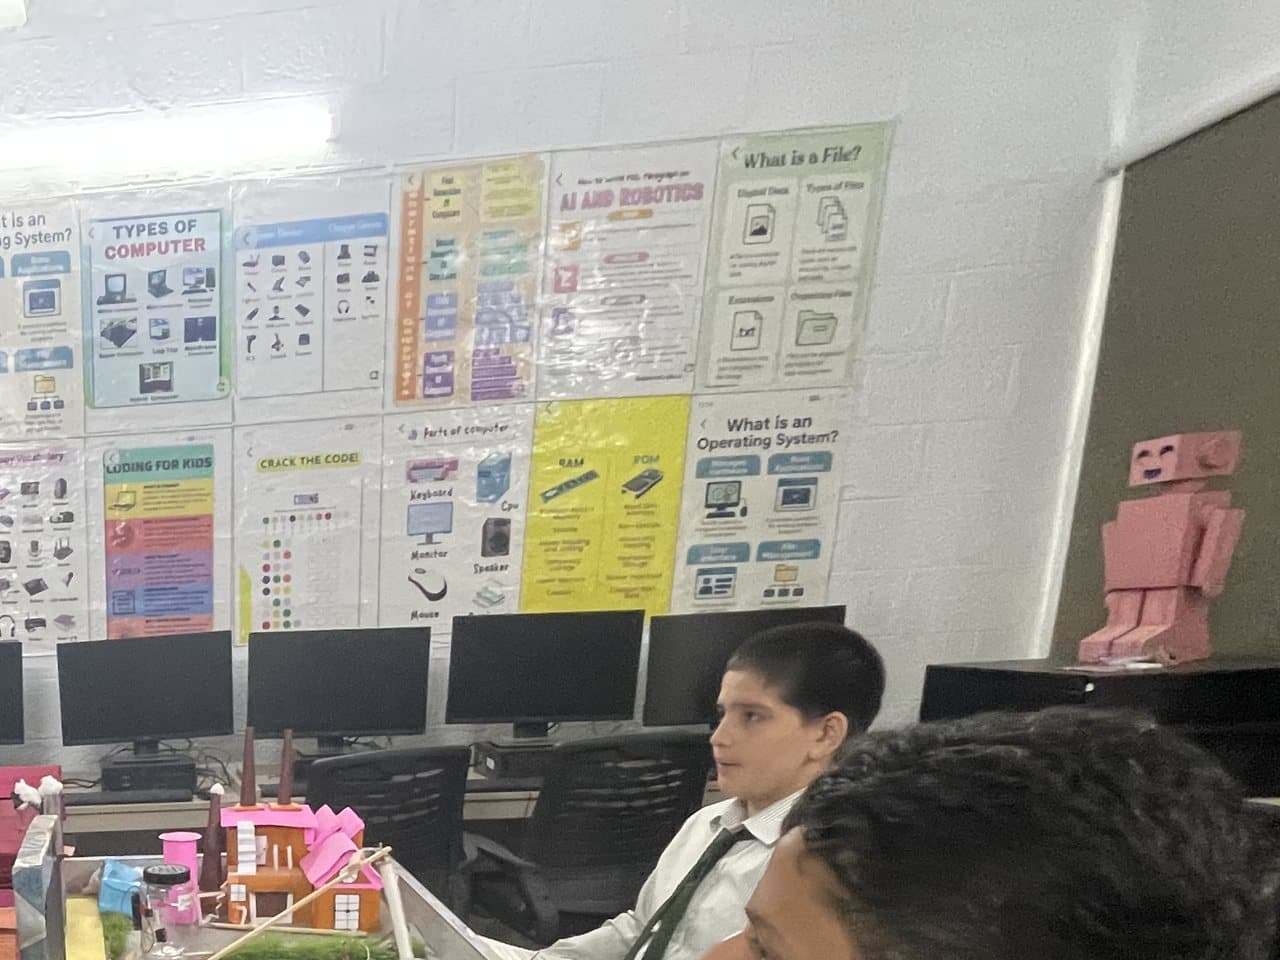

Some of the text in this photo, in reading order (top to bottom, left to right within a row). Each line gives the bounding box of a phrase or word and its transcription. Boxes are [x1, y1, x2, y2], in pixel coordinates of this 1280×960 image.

[744, 145, 862, 168] What is a File?
[560, 183, 704, 212] AI AND ROBOTICS
[28, 214, 46, 227] an
[112, 220, 197, 240] TYPES OF
[15, 228, 72, 248] System?
[105, 238, 206, 260] COMPUTER
[728, 414, 812, 432] What is an
[451, 426, 461, 436] of
[697, 430, 839, 452] Operating System?
[156, 460, 179, 471] FOR
[182, 457, 212, 469] KIDS
[260, 453, 358, 468] CRACK THE CODE!
[410, 488, 453, 500] Keyboard
[501, 501, 519, 512] Cpu
[411, 550, 448, 560] Monitor
[474, 563, 509, 574] Speaker
[411, 610, 439, 620] Mouse
